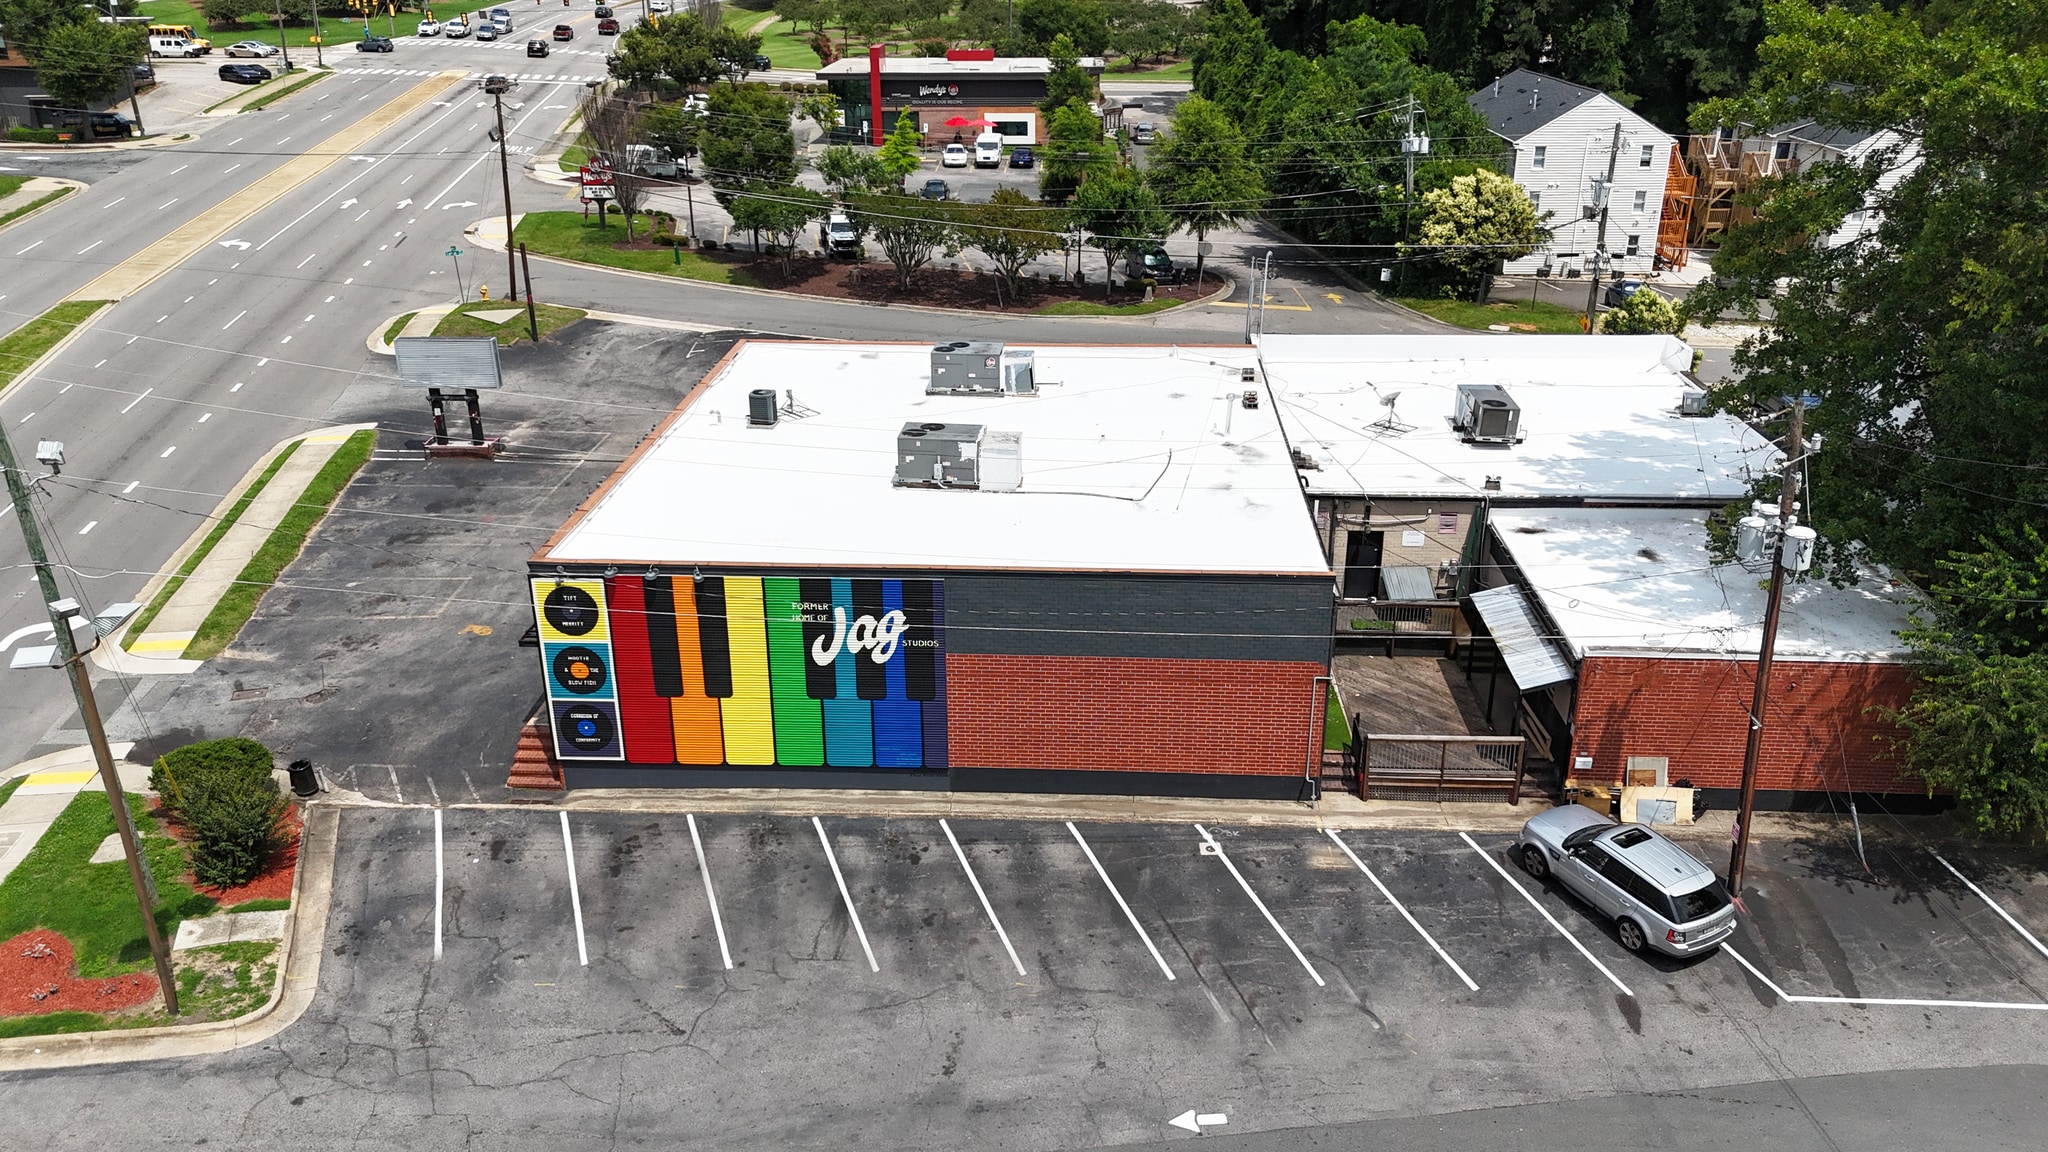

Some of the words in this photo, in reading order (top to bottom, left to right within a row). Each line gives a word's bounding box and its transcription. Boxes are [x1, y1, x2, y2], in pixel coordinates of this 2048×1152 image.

[919, 84, 946, 97] Wendy's
[791, 602, 829, 611] FORMER
[792, 614, 815, 622] HOME
[811, 606, 910, 667] Jag
[902, 639, 940, 648] STUDIOS
